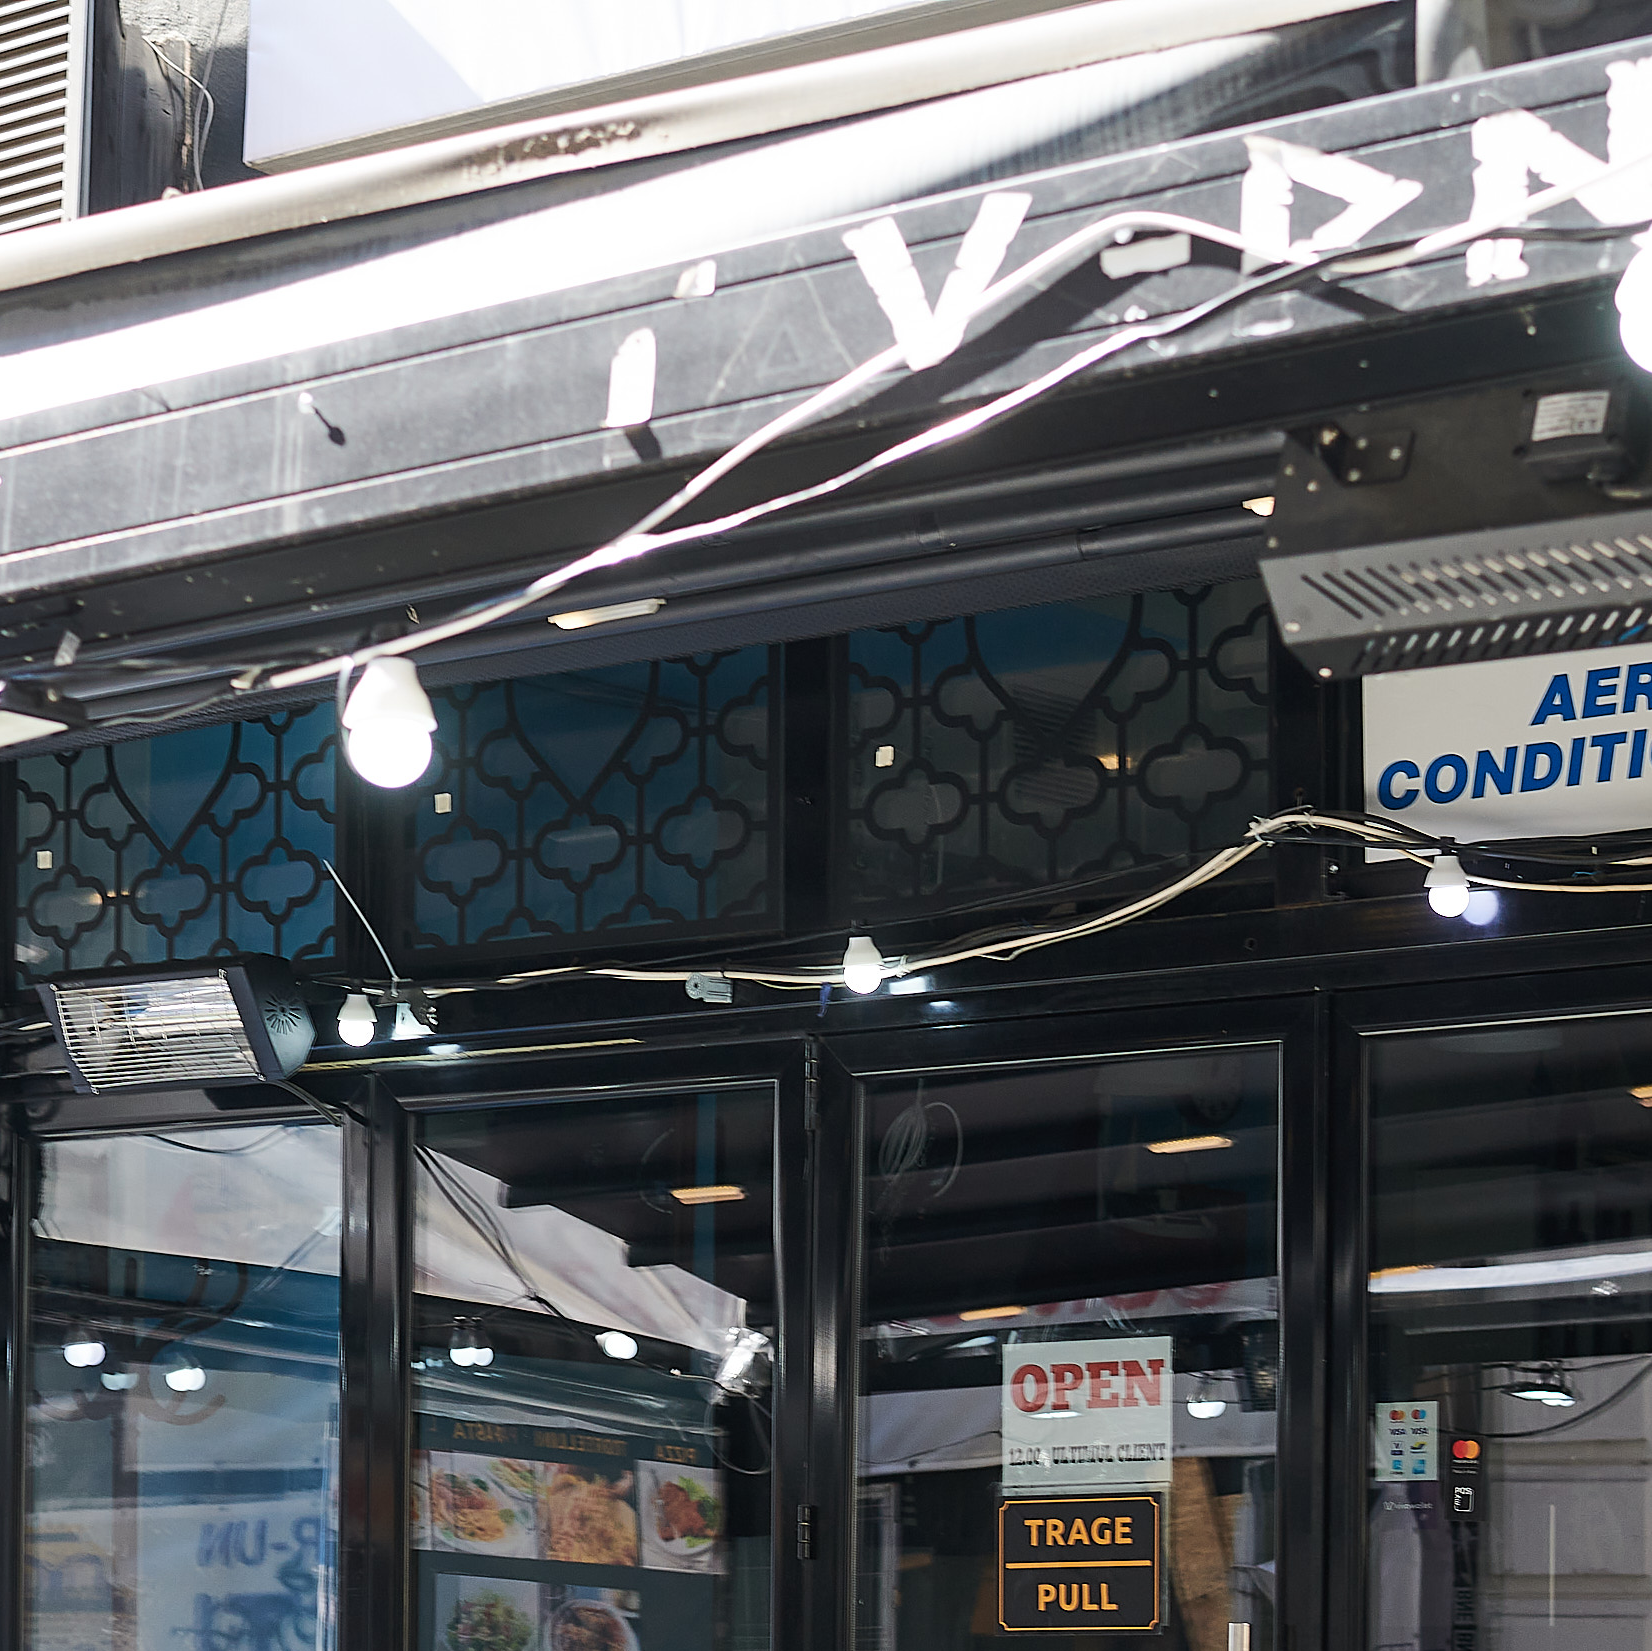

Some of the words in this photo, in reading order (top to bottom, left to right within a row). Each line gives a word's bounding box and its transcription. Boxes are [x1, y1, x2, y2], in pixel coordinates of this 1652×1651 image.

[1010, 1358, 1165, 1413] OPEN
[1024, 1516, 1133, 1546] TRAGE
[1037, 1583, 1119, 1611] PULL
